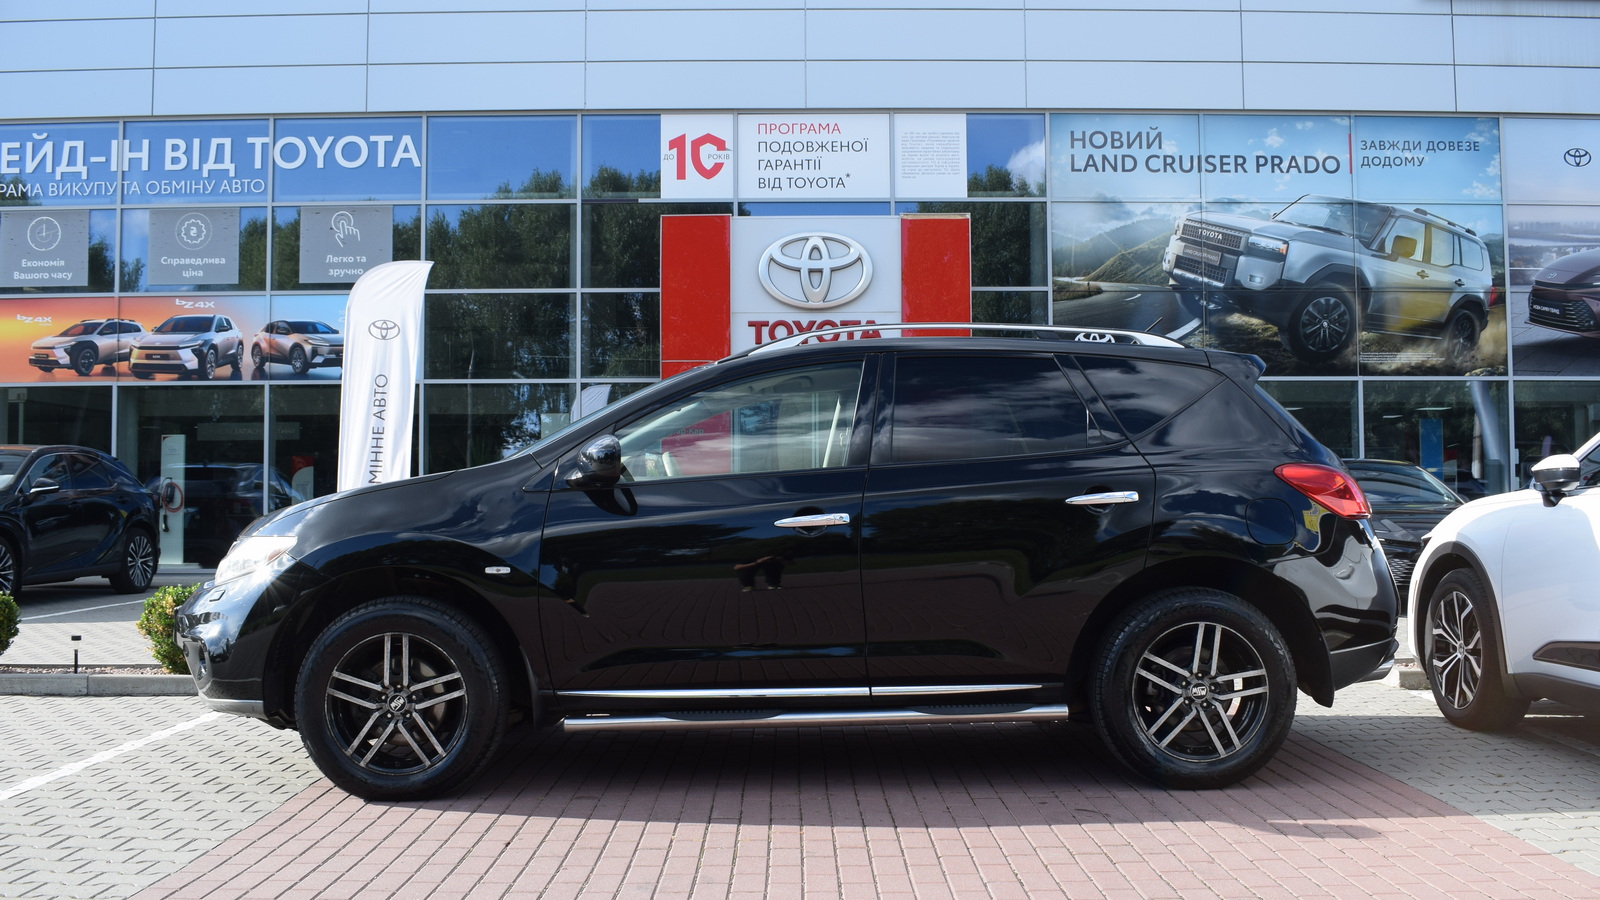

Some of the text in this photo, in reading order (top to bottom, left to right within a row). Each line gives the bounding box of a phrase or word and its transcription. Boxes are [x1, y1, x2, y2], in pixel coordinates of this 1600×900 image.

[757, 123, 841, 135] ПРОГРАМА
[1069, 126, 1163, 150] НОВИЙ
[757, 138, 868, 155] ПОДОВЖЕНОЇ
[1360, 140, 1480, 154] ЗАВЖДИ ДОВЕЗЕ
[165, 138, 235, 177] ВІД
[247, 134, 422, 169] TOYOTA
[663, 153, 675, 161] ДО
[1360, 155, 1425, 169] ДОДОМУ
[757, 157, 822, 171] ГАРАНТІЇ
[1069, 154, 1341, 175] LAND CRUISER PRADO
[49, 182, 117, 196] ВИКУПУ
[122, 181, 141, 195] ТА
[146, 179, 215, 195] ОБМІНУ
[219, 178, 265, 194] АВТО
[758, 177, 782, 191] ВІД
[21, 259, 65, 268] Економія
[161, 256, 226, 267] Справедлива
[326, 255, 367, 264] Легко та
[13, 271, 73, 281] Вашого часу
[182, 268, 204, 279] ціна
[328, 267, 363, 277] зручно
[748, 320, 882, 345] TOYOTA
[368, 374, 388, 484] МІННЕ АВТО
[1192, 686, 1207, 697] MSW
[390, 695, 405, 711] MSW
